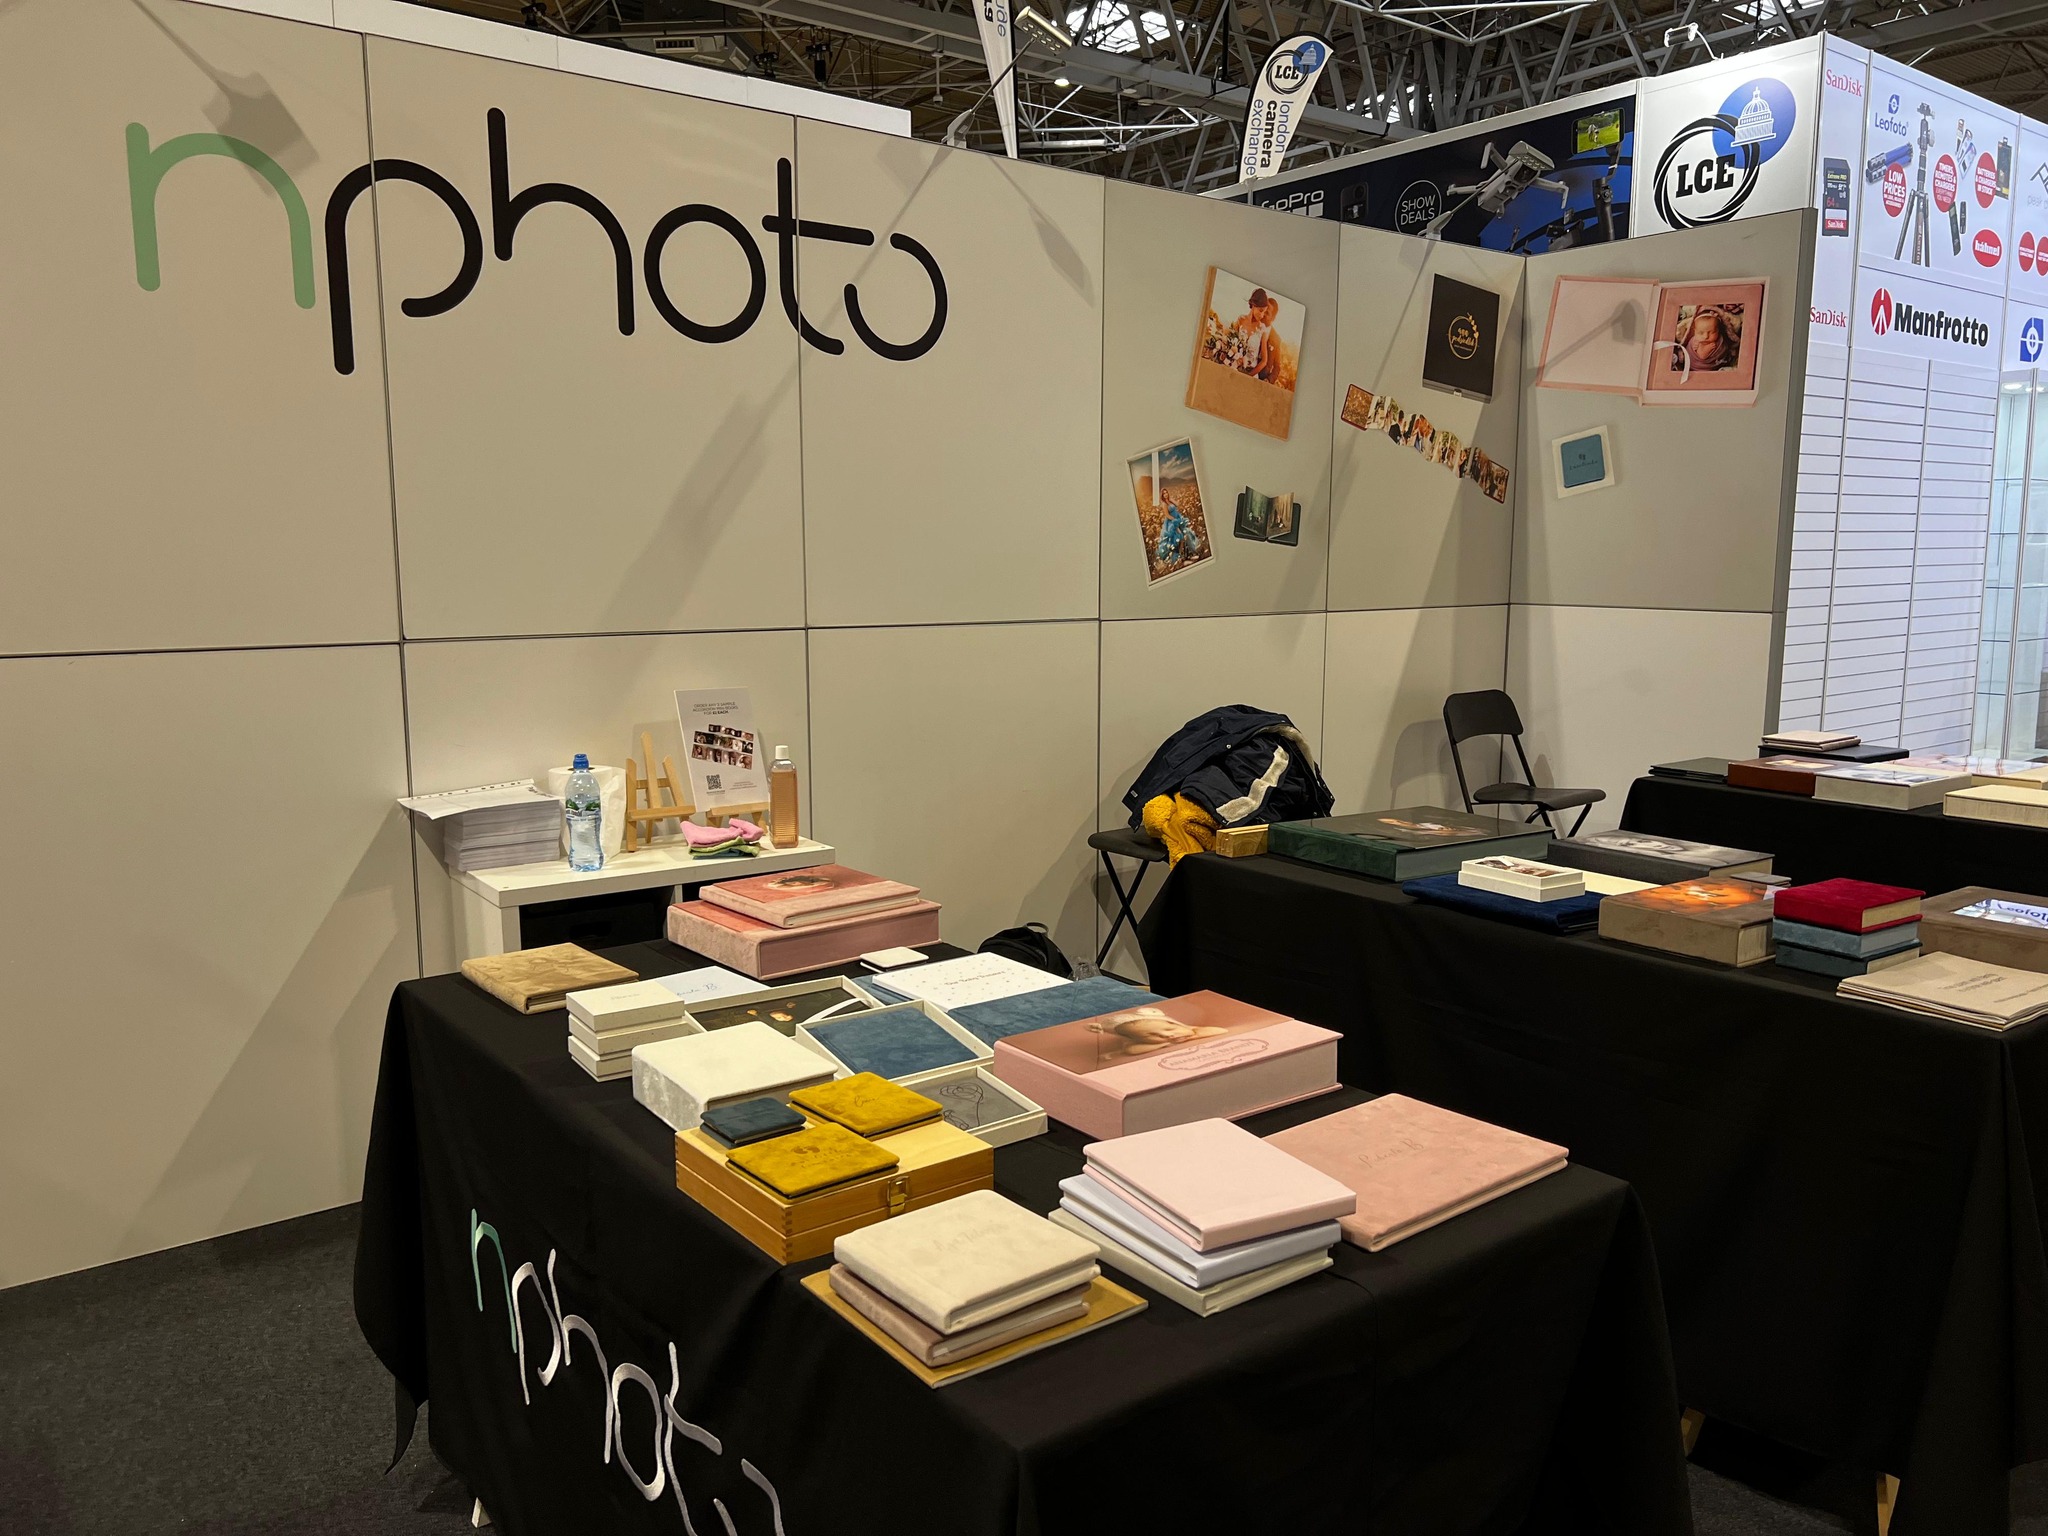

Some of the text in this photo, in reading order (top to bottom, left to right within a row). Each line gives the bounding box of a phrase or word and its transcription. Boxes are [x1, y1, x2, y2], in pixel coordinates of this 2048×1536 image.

[1275, 64, 1300, 81] LCE
[1825, 68, 1862, 97] SanDisk
[1260, 100, 1278, 168] camera
[1275, 100, 1294, 153] london
[1875, 112, 1907, 136] Leofoto
[1244, 99, 1264, 176] exchange
[1676, 153, 1736, 198] LCE
[1888, 170, 1903, 184] LOW
[1262, 190, 1324, 210] GoPro
[1883, 181, 1906, 198] PRICES
[1401, 195, 1436, 213] SHOW
[1400, 208, 1435, 226] DEALS
[125, 107, 947, 375] nphoto
[1809, 306, 1847, 328] SanDisk
[1894, 302, 1989, 347] Manfrotto
